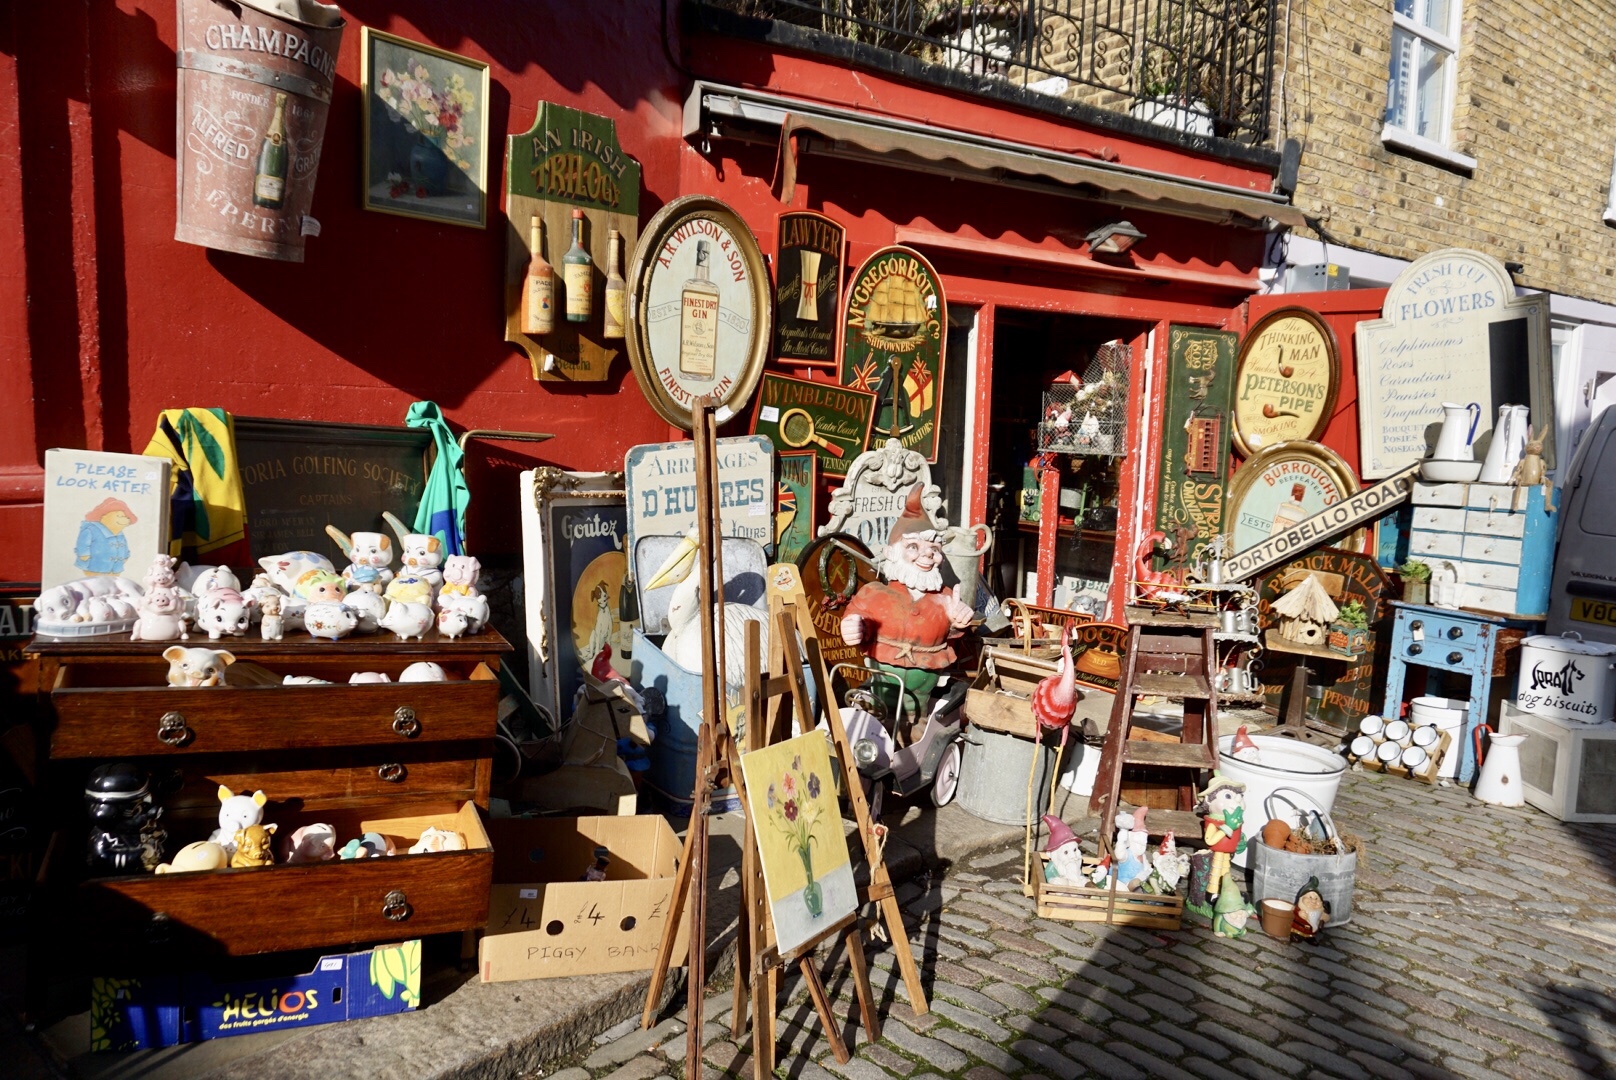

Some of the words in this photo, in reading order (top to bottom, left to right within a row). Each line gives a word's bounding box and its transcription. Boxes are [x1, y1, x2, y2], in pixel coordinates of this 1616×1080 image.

[205, 23, 335, 84] CHAMPAGNE
[532, 128, 562, 158] AN
[572, 128, 627, 179] IRISH
[531, 152, 620, 207] TRILOGY
[782, 218, 840, 258] LAWYER
[672, 219, 723, 244] WILSON
[720, 239, 732, 252] &
[727, 250, 746, 282] SON
[1406, 262, 1452, 295] FRESH
[1458, 263, 1487, 285] CUT
[683, 297, 705, 308] FINEST
[705, 300, 717, 310] DRY
[692, 309, 708, 319] GIN
[1401, 290, 1495, 321] FLOWERS
[866, 335, 916, 353] SHIPOWNERS
[1260, 331, 1316, 351] THINKING
[1289, 344, 1321, 361] MAN
[659, 368, 692, 405] FINEST
[713, 375, 732, 399] GIN
[1240, 373, 1326, 401] PETERSON'S
[1380, 371, 1452, 387] Carnations
[765, 379, 870, 424] WIMBLEDON
[1279, 396, 1314, 413] PIPE
[1382, 388, 1437, 402] Pansies
[814, 415, 837, 433] Centre
[837, 420, 859, 436] Court
[1252, 420, 1297, 435] SMOKING
[1383, 434, 1418, 444] POSIES
[1383, 444, 1433, 454] NOSEGAYS
[75, 462, 137, 478] PLEASE
[292, 456, 357, 477] GOLFING
[362, 462, 421, 496] SOCIETY
[57, 475, 98, 490] LOOK
[102, 479, 152, 496] AFTER
[1263, 462, 1339, 506] BURROUGH'S
[1278, 475, 1323, 496] BEEFEATER
[299, 493, 352, 506] CAPTAINS
[641, 478, 764, 518] D'HURES
[854, 496, 894, 512] FRESH
[1183, 480, 1210, 539] OMNIBUS
[561, 512, 622, 550] Goûtez
[1228, 508, 1349, 578] PORTOBELLO
[1351, 477, 1410, 517] ROAD
[1268, 555, 1335, 593] PARICK
[1519, 691, 1541, 708] dog
[1544, 695, 1598, 716] biscuits
[573, 900, 605, 926] £4
[527, 946, 587, 961] PIGGY
[607, 942, 660, 957] BANK
[219, 1022, 232, 1030] des
[232, 1020, 252, 1028] fruits
